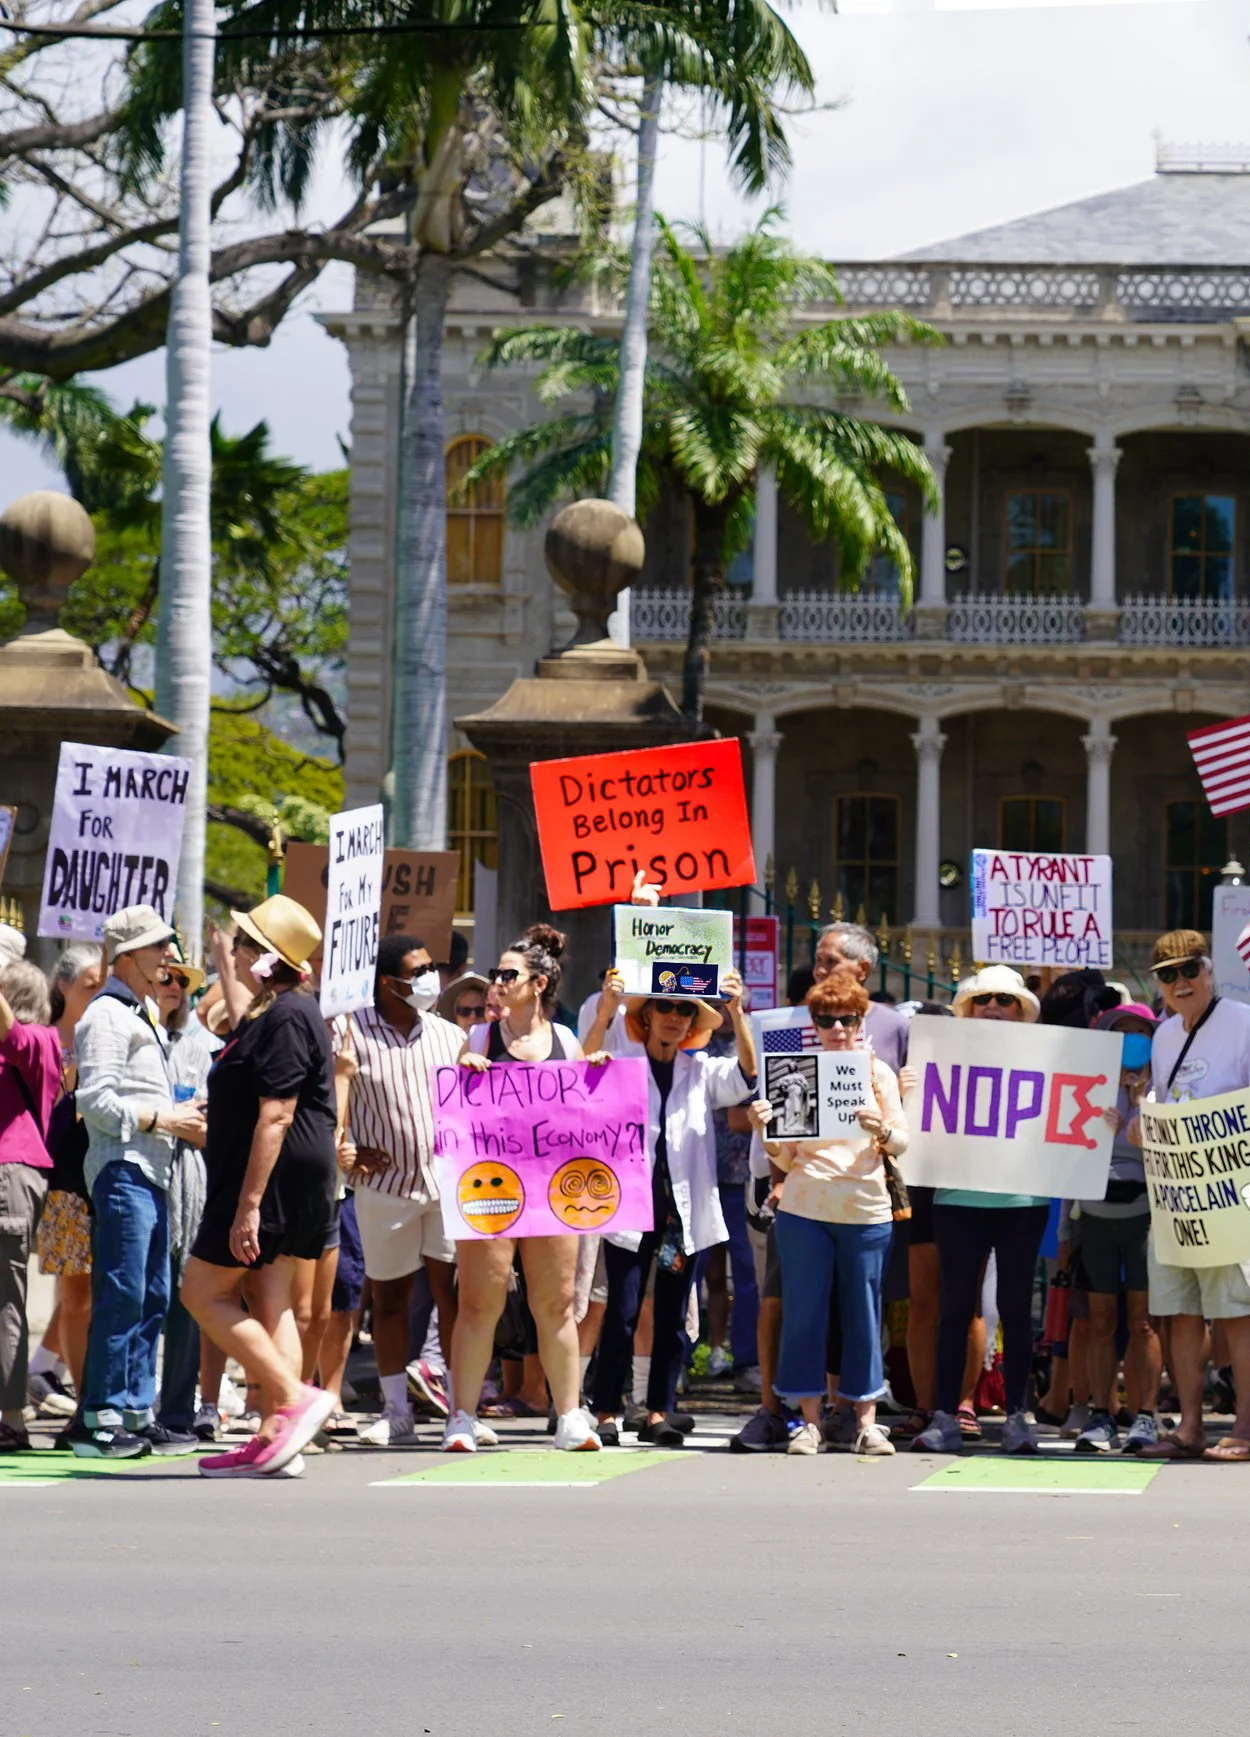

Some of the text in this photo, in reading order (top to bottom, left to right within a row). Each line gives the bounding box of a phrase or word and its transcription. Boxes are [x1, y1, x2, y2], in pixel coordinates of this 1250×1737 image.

[73, 763, 189, 804] I MARCH
[560, 768, 715, 807] Dictators
[79, 809, 113, 839] FOR
[573, 801, 708, 839] Belong In
[335, 820, 383, 863] I MARCH
[47, 847, 169, 922] DAUGHTER
[572, 845, 731, 894] Prison
[990, 855, 1095, 884] A TYRANT
[1001, 882, 1027, 908] IS
[1029, 883, 1102, 912] UNFIT
[632, 918, 675, 937] Honor
[989, 908, 1101, 939] TO RULE A
[329, 911, 379, 981] FUTURE
[646, 940, 712, 963] Democracy
[987, 935, 1110, 965] FREE PEOPLE
[836, 1065, 856, 1076] We
[437, 1067, 586, 1108] DICTATOR
[830, 1082, 863, 1092] Must
[828, 1097, 866, 1109] Speak
[838, 1113, 856, 1124] Up
[1181, 1104, 1250, 1144] THRONE
[437, 1120, 459, 1150] in
[470, 1121, 523, 1156] this
[1169, 1151, 1204, 1179] THIS
[1159, 1178, 1240, 1213] PORCELAIN
[1173, 1218, 1210, 1246] ONE!
